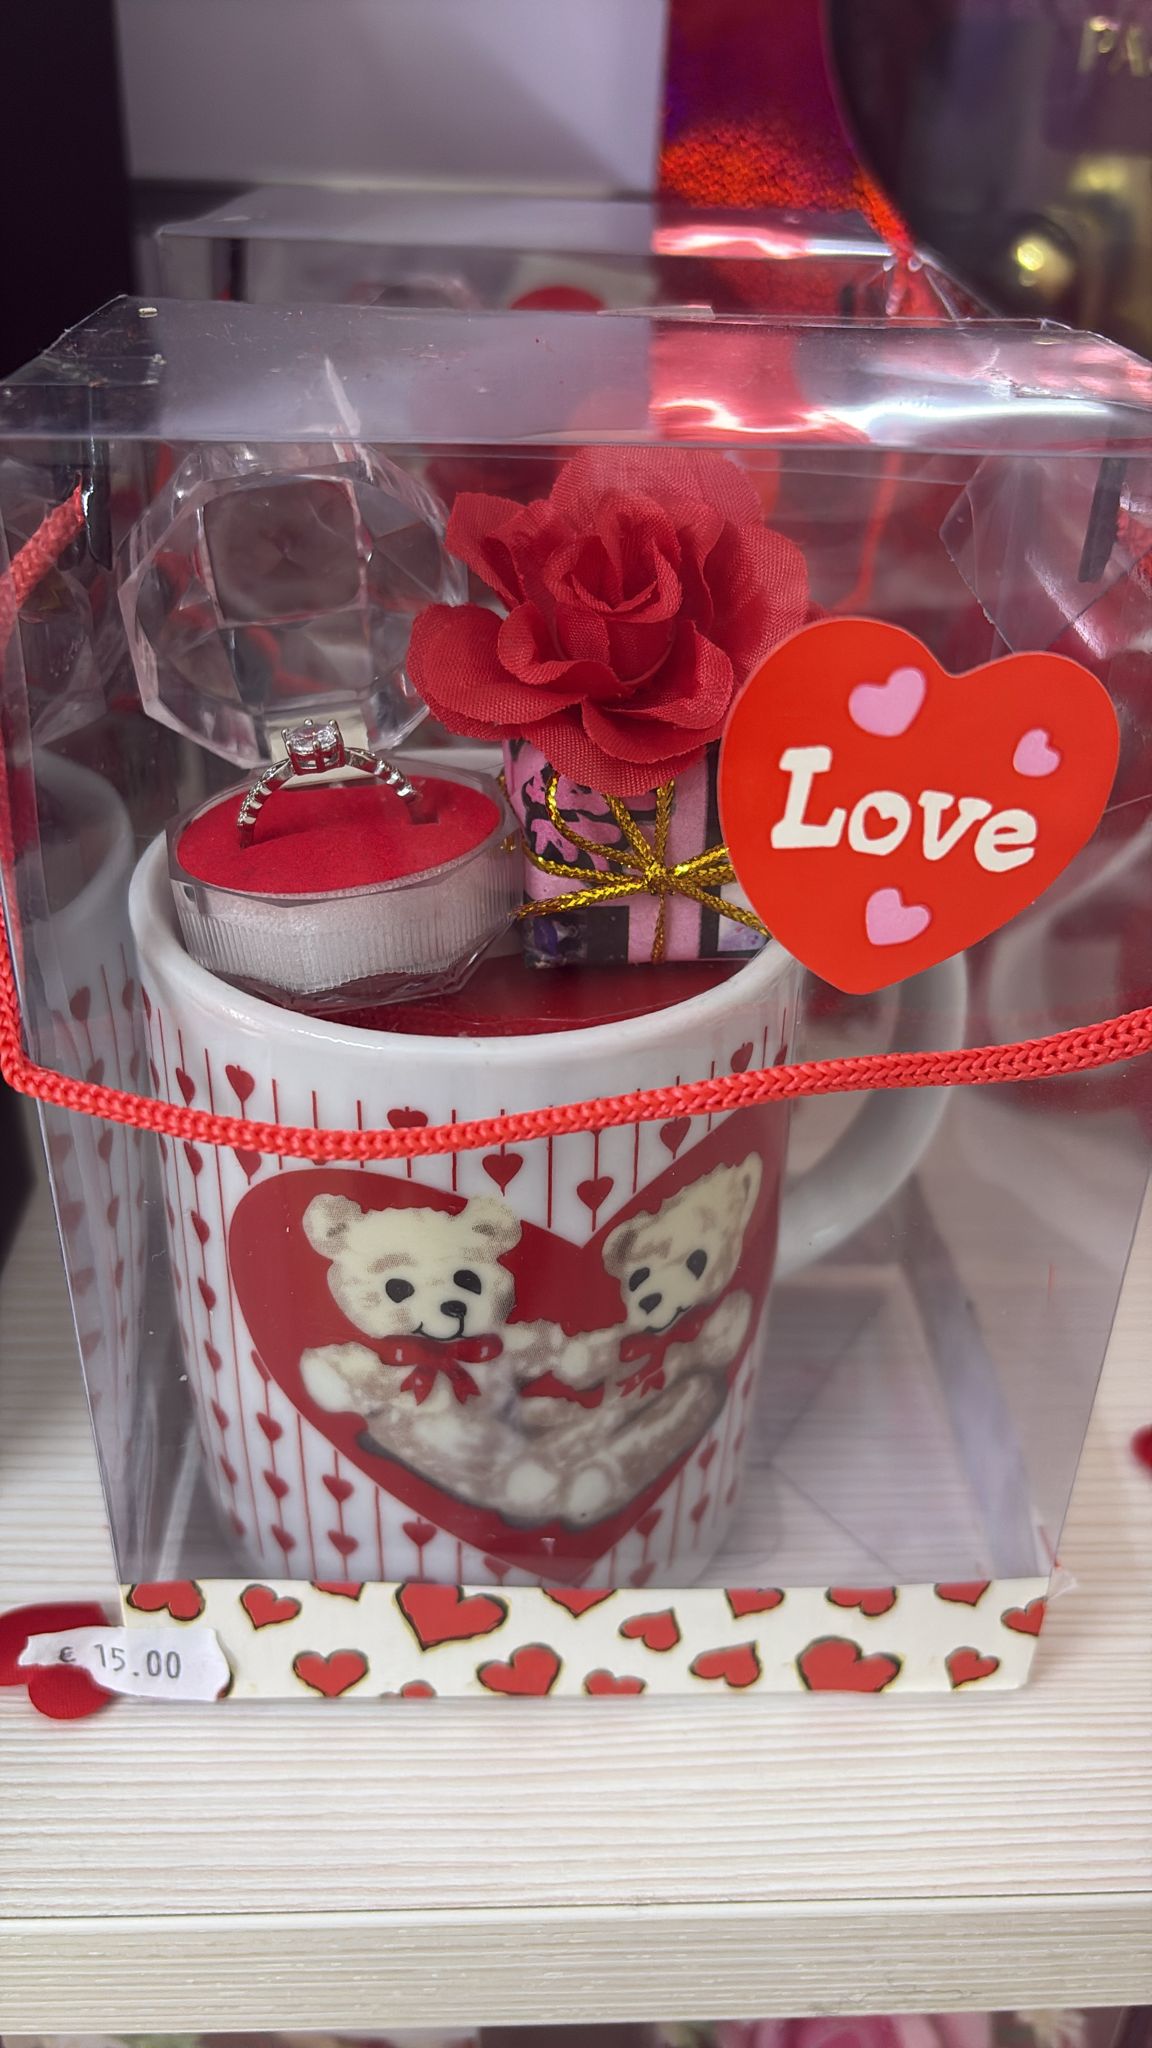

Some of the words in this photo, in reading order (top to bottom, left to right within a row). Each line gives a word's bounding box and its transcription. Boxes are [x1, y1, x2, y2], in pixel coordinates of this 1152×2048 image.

[771, 745, 1038, 873] Love
[58, 1645, 76, 1663] €
[94, 1643, 182, 1679] 15.00
